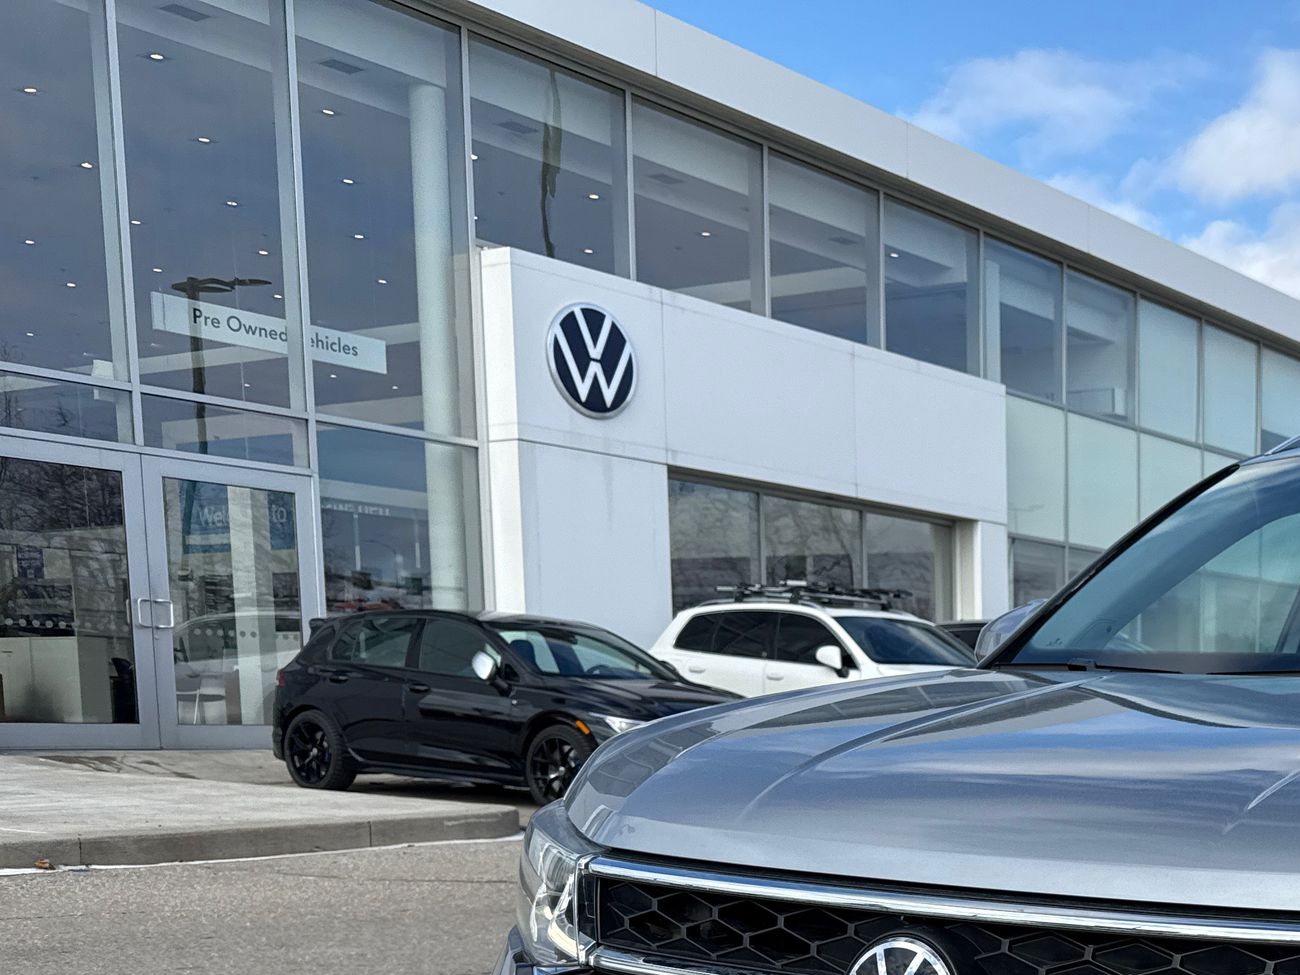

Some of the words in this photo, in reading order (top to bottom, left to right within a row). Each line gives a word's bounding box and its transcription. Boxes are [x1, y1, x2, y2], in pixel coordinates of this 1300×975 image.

[192, 307, 221, 329] Pre
[226, 315, 288, 343] Owned
[310, 332, 359, 356] hicles
[551, 305, 634, 410] VW
